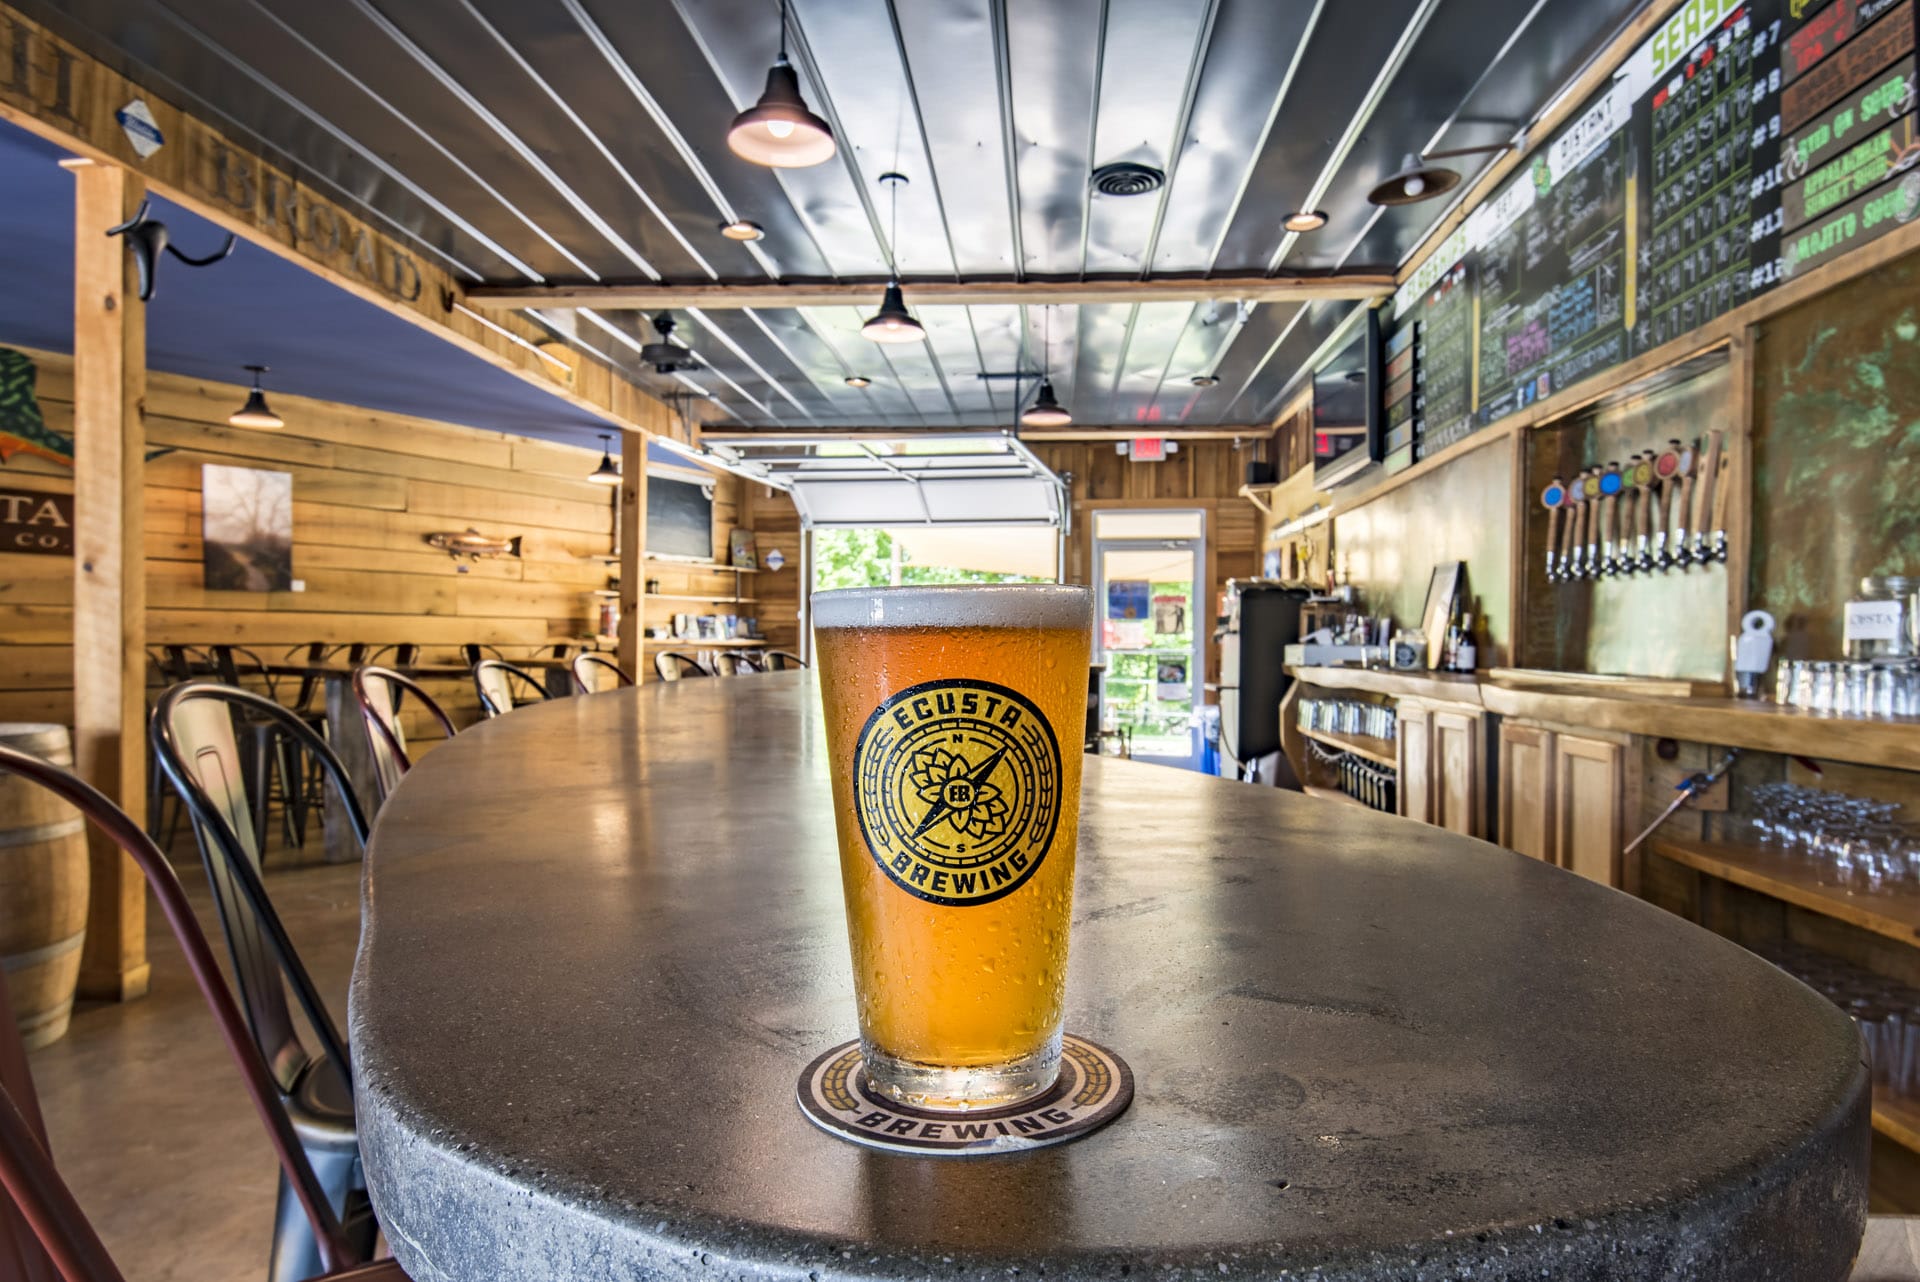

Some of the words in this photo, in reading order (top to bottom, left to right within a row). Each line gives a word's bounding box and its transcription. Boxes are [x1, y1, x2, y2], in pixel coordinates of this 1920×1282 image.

[1752, 68, 1781, 104] #8
[1752, 114, 1781, 149] #9
[208, 134, 422, 302] BROAD
[1796, 213, 1856, 264] MOJITO
[0, 496, 69, 528] TA
[893, 693, 1023, 731] ECUSTA
[953, 734, 963, 743] N
[956, 844, 965, 853] S
[892, 850, 1029, 893] BREWING
[855, 1107, 1073, 1140] BREWING
